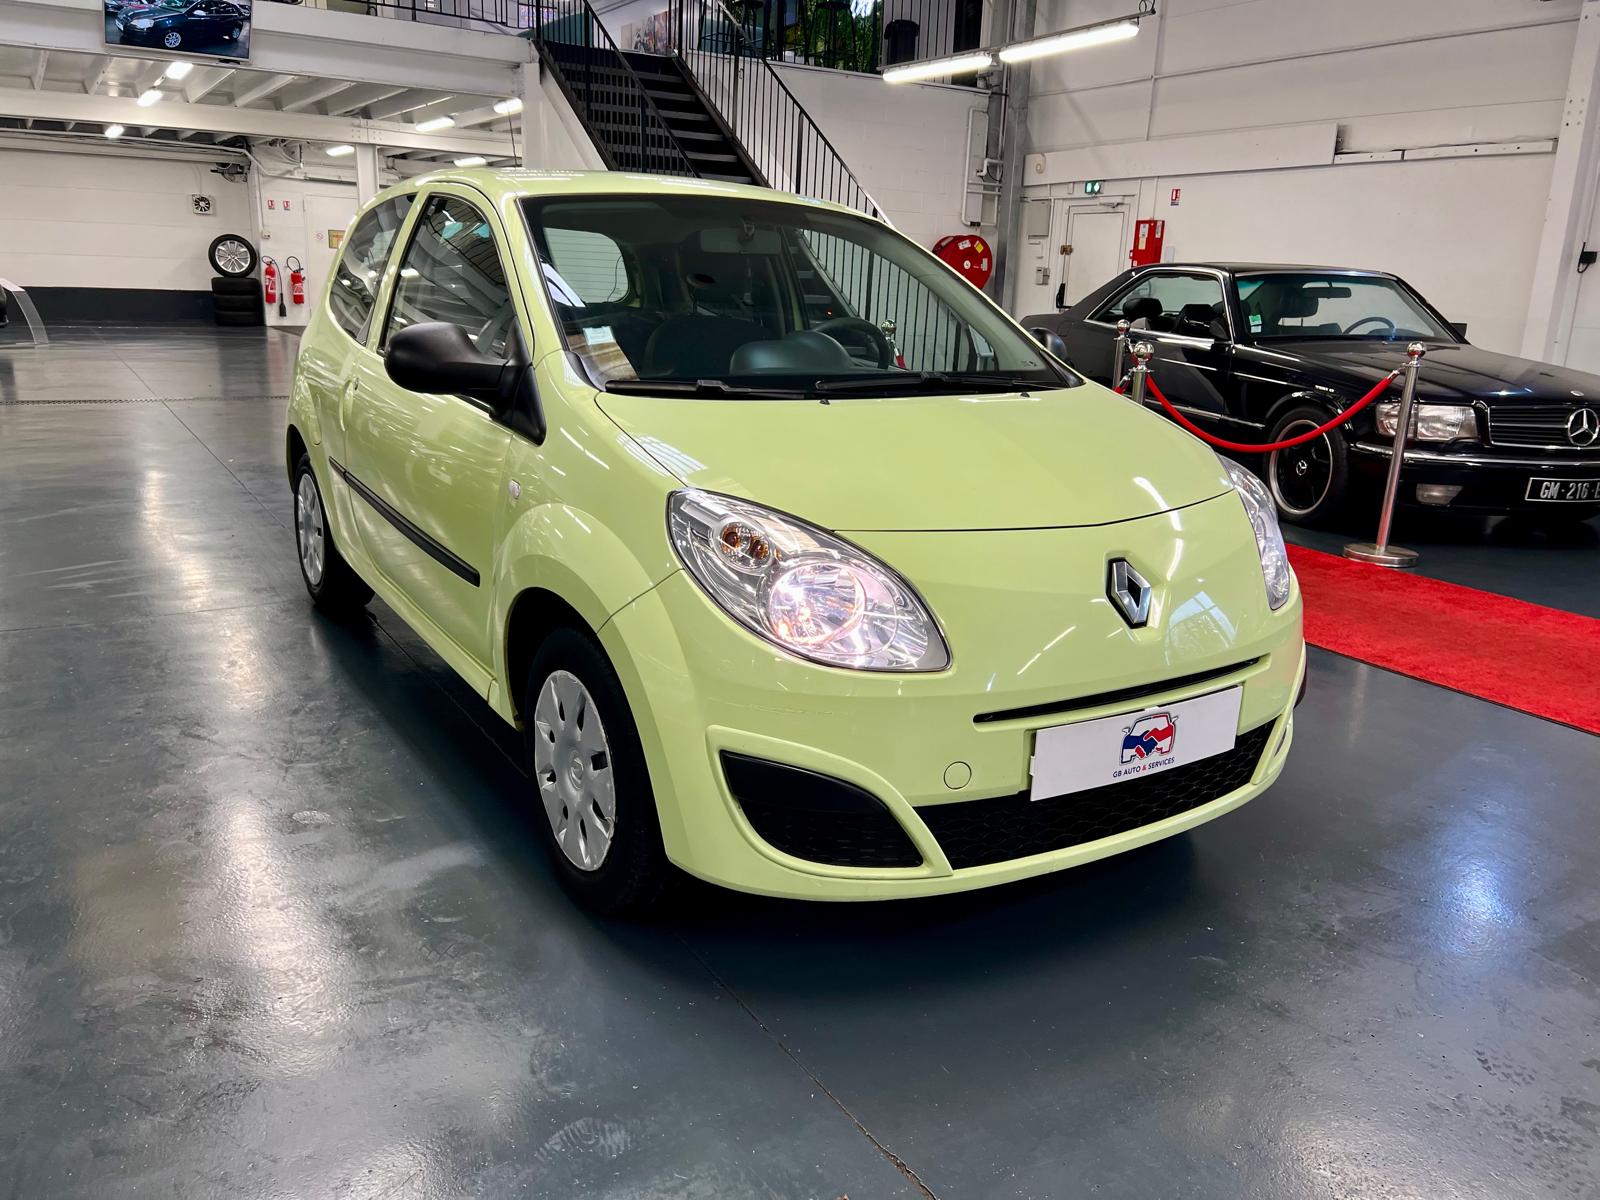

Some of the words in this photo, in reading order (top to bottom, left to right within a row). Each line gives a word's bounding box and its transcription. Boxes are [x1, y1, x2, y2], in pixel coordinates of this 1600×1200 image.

[1113, 770, 1122, 778] GB
[1123, 765, 1141, 776] AUTO
[1148, 757, 1175, 770] SERVICES
